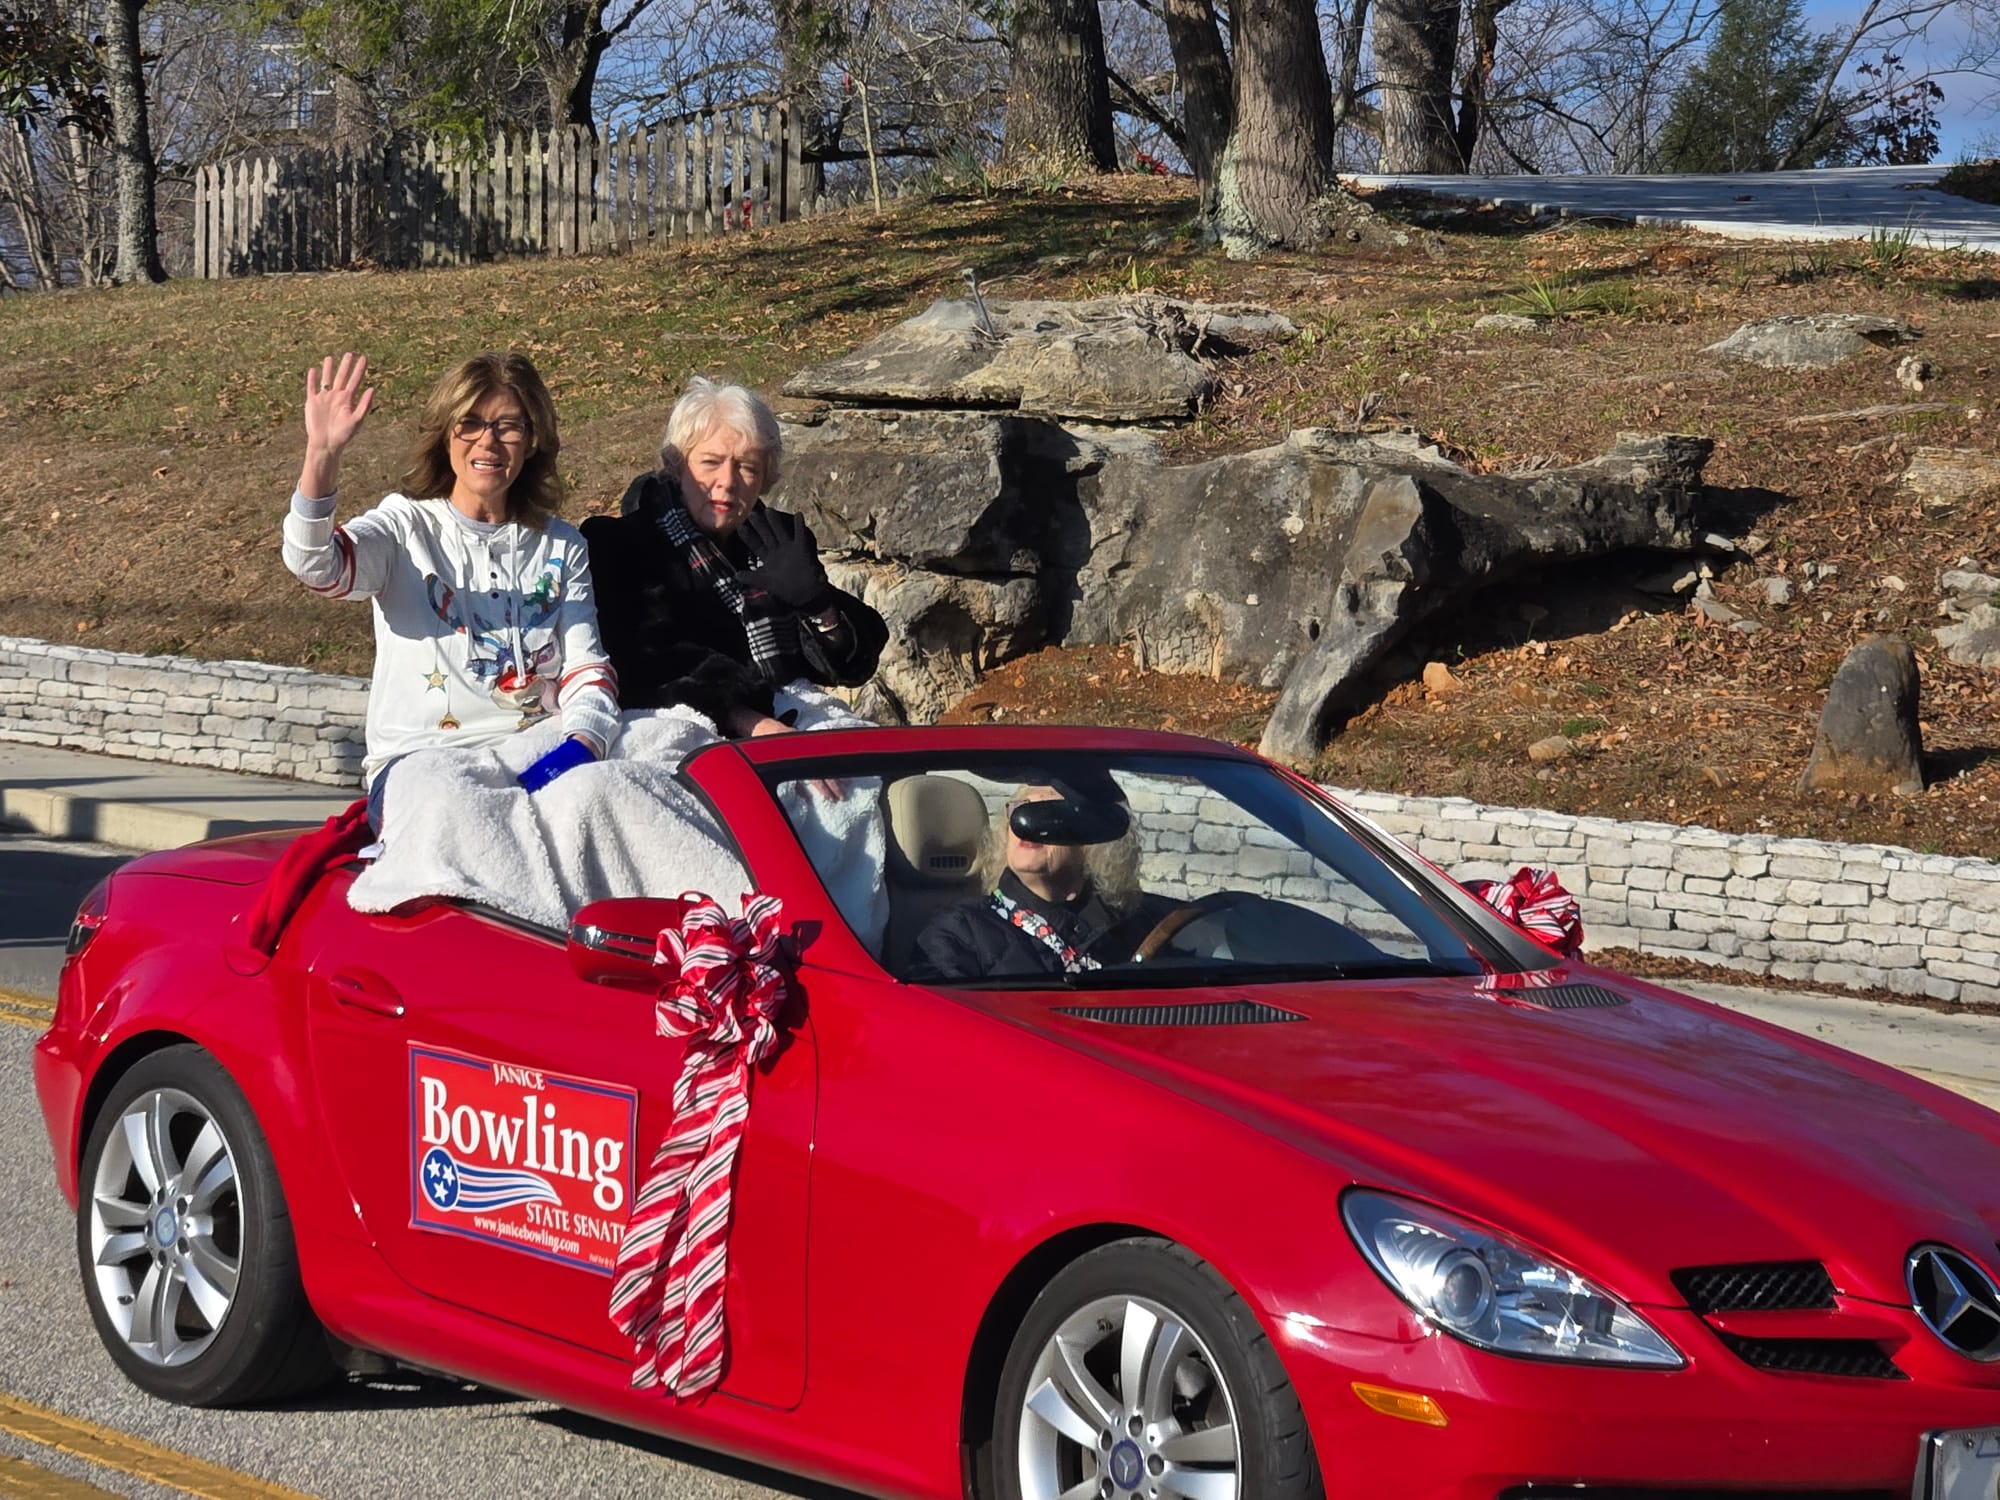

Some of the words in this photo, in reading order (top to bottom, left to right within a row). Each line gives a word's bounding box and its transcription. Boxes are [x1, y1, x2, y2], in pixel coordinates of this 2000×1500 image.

[492, 1063, 545, 1091] JANICE
[420, 1076, 624, 1211] Bowling
[526, 1202, 570, 1232] STATE
[473, 1216, 580, 1254] www.janicebowling.com
